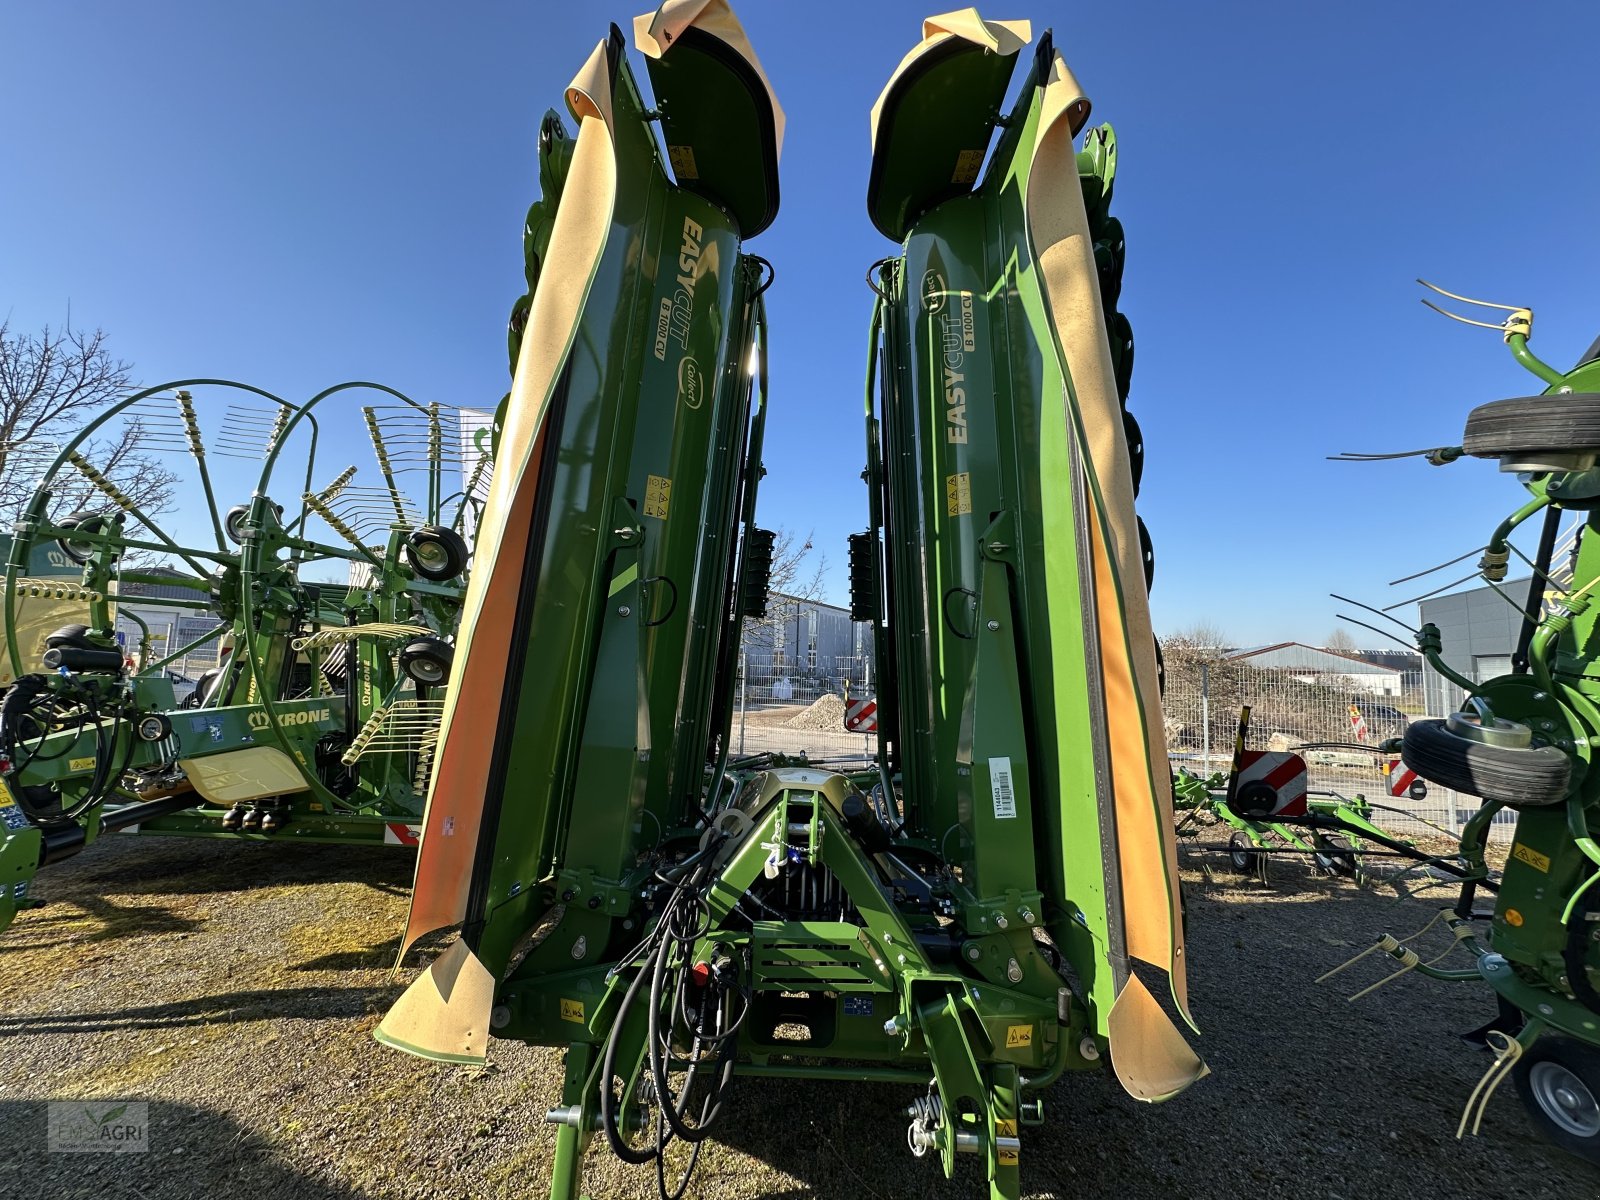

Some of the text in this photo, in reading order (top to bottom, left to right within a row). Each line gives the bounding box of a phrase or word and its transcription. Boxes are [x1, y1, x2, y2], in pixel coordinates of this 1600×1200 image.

[670, 216, 703, 350] EASYCUT
[655, 302, 671, 357] B 1000 CV
[963, 294, 974, 347] B 1000 CV
[687, 364, 696, 402] Collect
[942, 313, 968, 444] EASYCUT
[277, 708, 330, 727] KRONE
